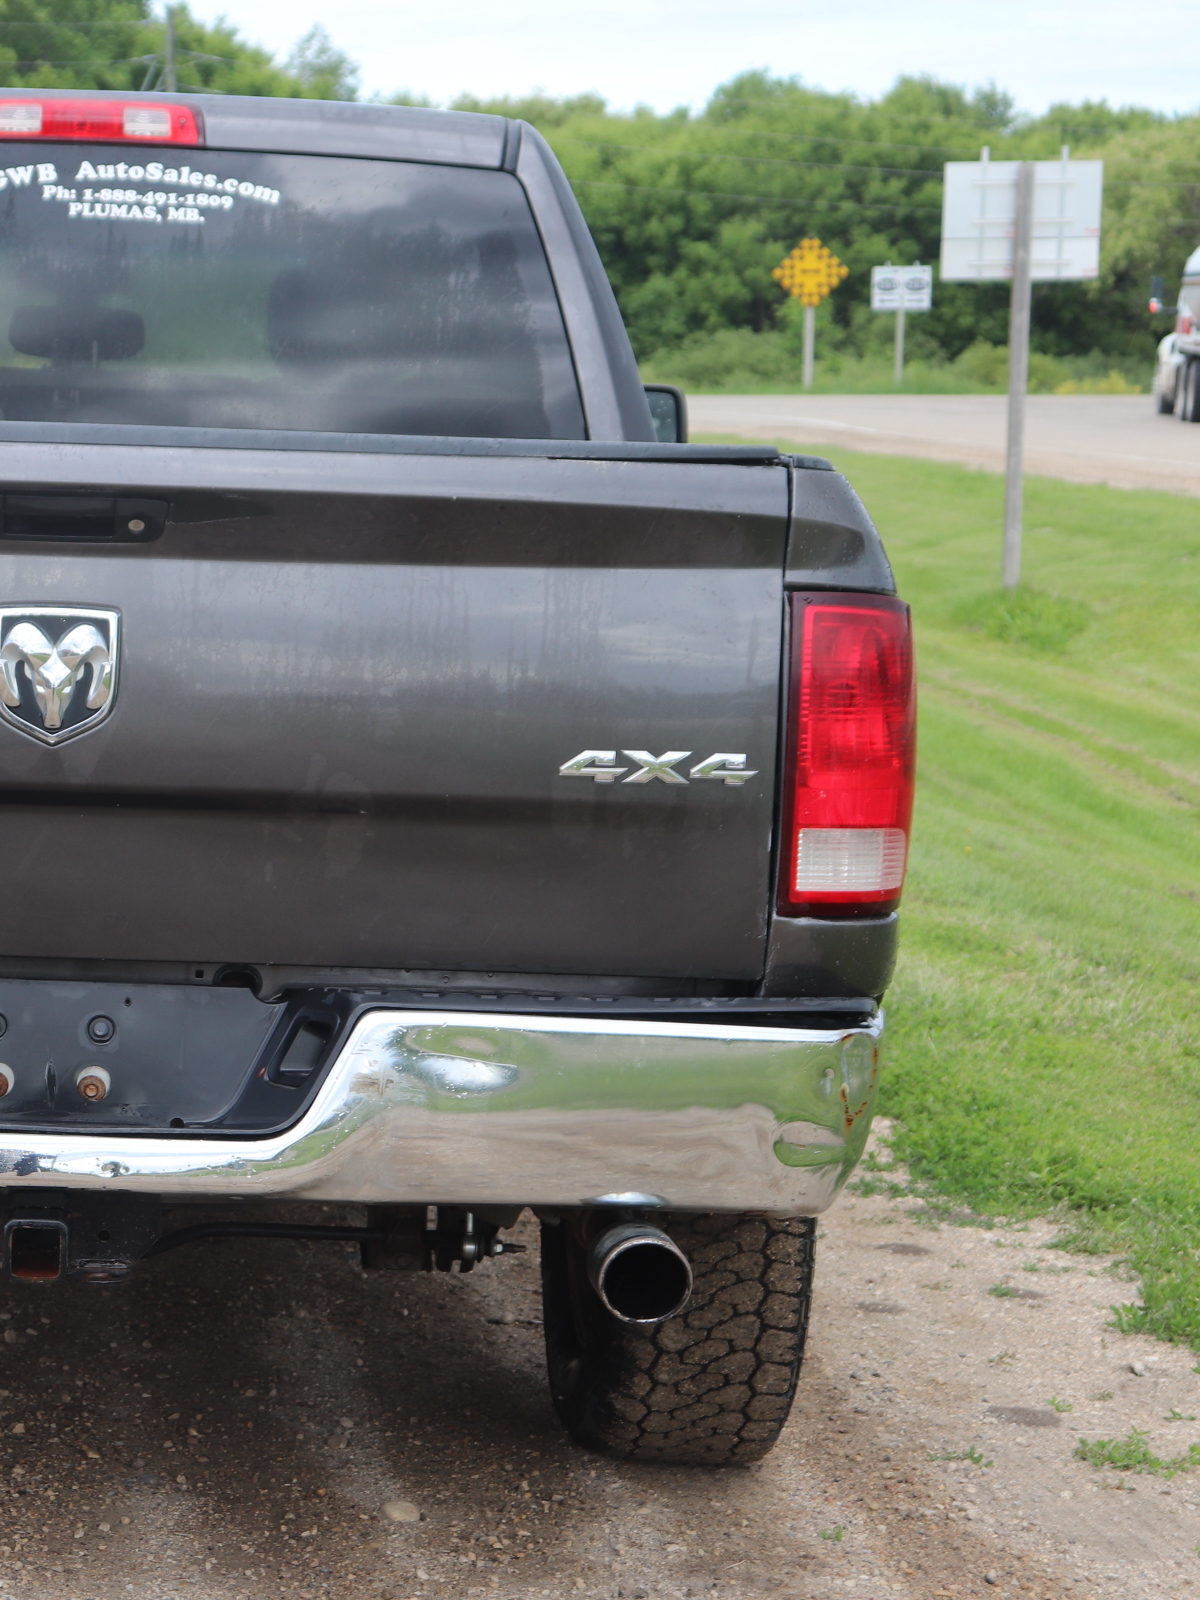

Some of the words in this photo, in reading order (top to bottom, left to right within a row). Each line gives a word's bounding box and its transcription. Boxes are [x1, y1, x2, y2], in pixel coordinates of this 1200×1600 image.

[75, 160, 280, 203] AutoSales.com
[43, 185, 77, 200] Ph:
[83, 187, 233, 209] 1-888-491-1809
[69, 202, 162, 222] PLUMAS,
[167, 206, 205, 222] MB.
[559, 750, 759, 784] 4X4
